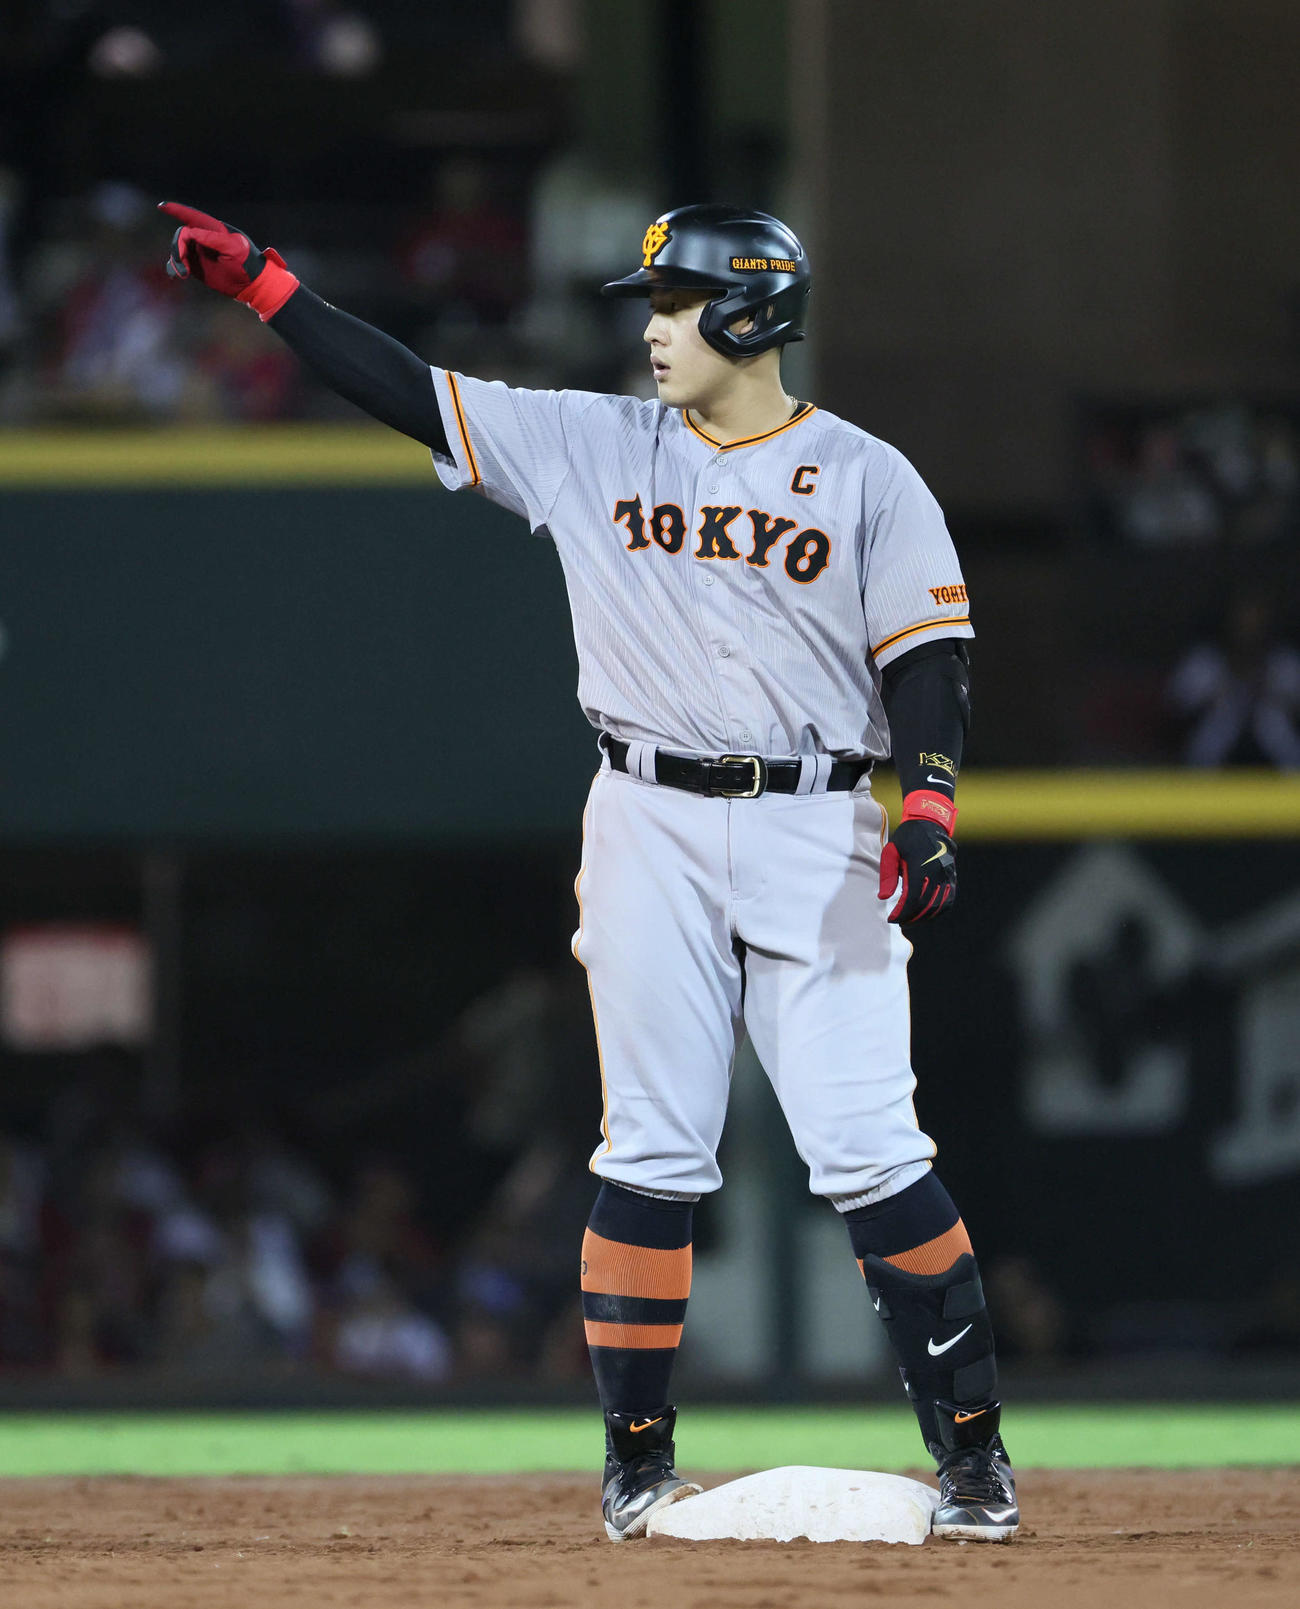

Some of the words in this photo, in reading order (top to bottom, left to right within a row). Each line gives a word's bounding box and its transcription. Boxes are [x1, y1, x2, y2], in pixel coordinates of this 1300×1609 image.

[732, 258, 768, 270] GIANTS
[770, 259, 796, 272] PRIDE
[790, 465, 820, 496] C
[613, 492, 832, 585] TOKYO
[928, 584, 969, 606] YOMI
